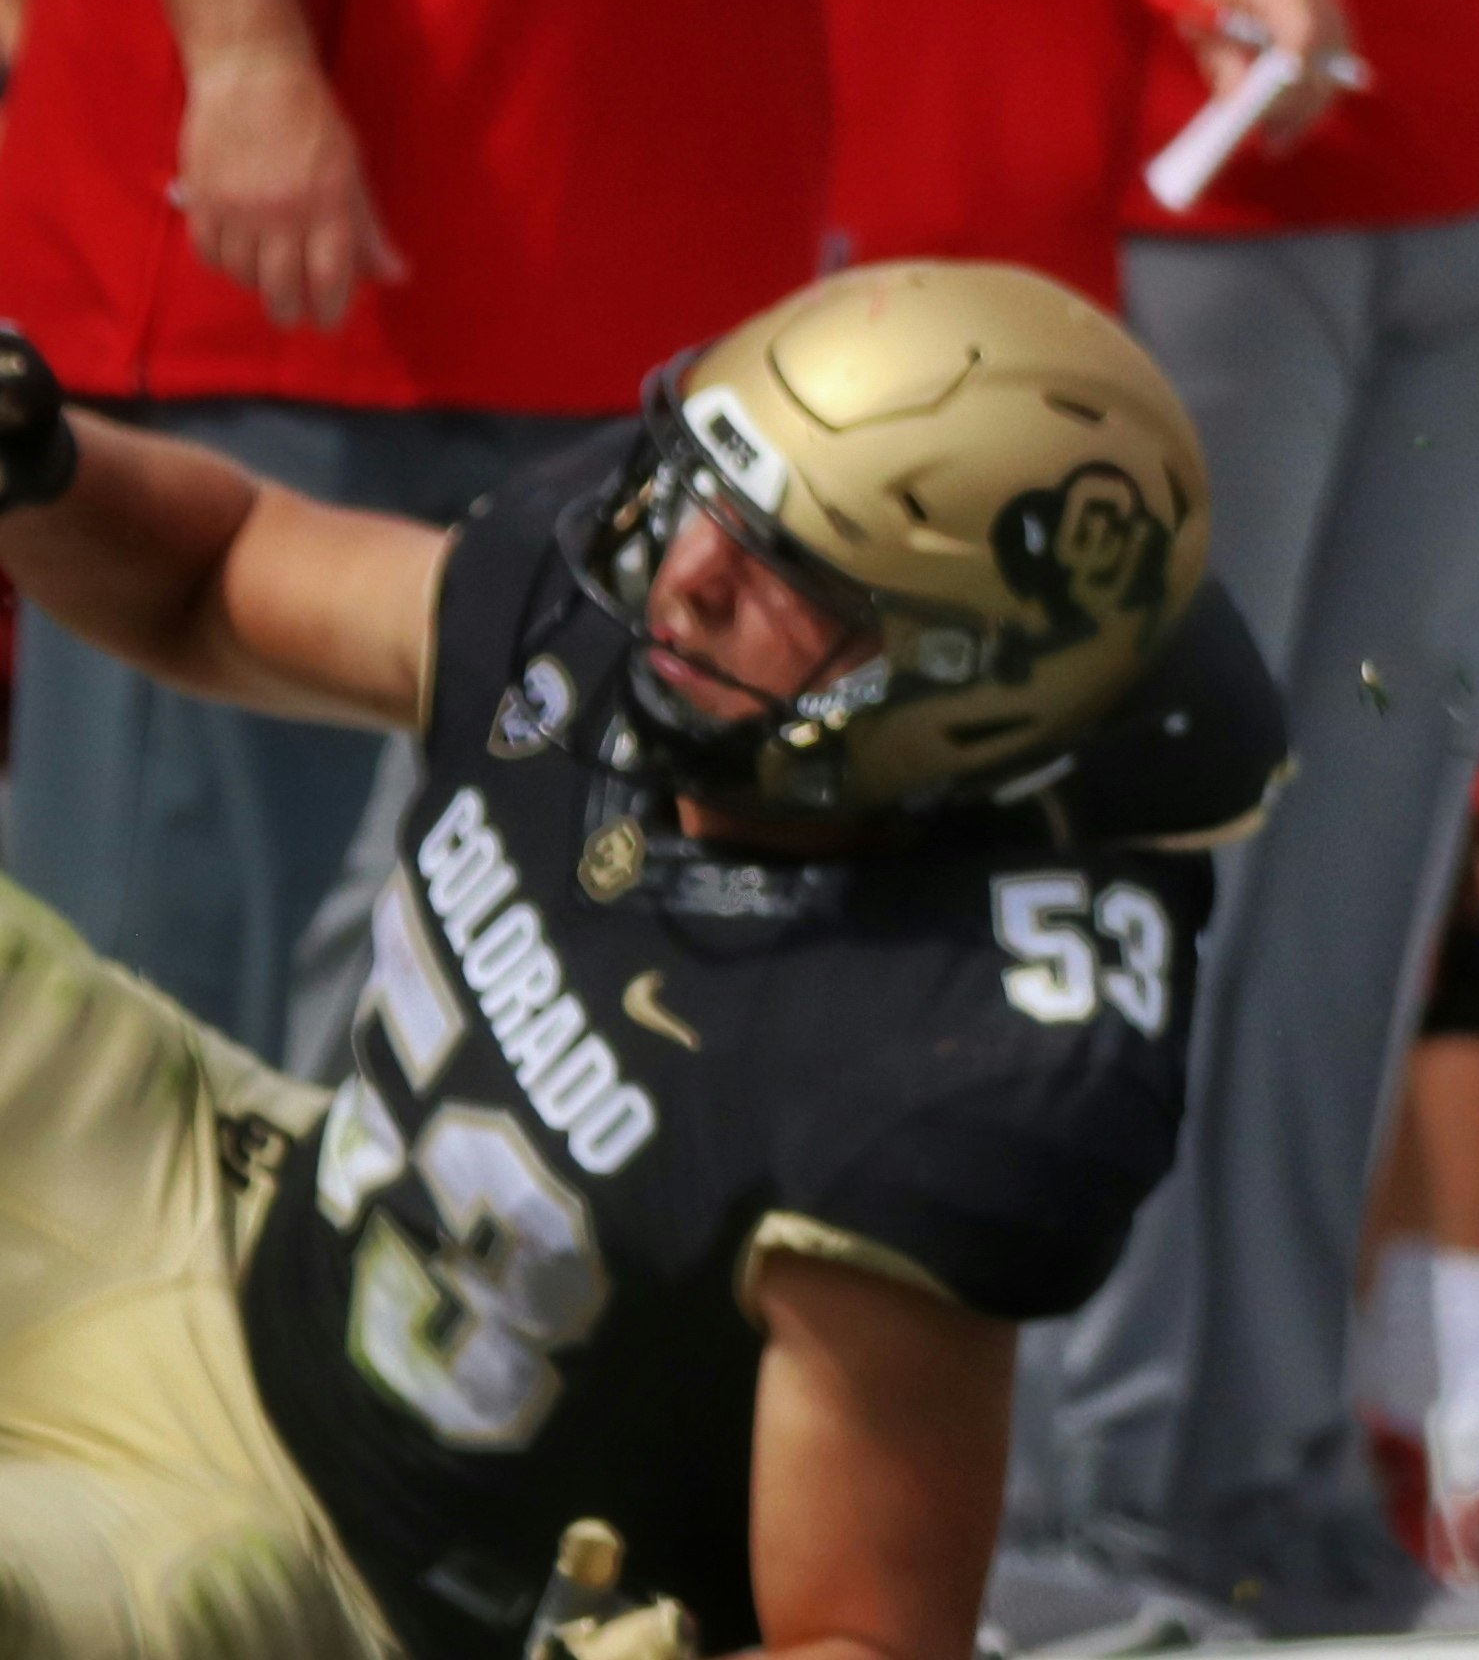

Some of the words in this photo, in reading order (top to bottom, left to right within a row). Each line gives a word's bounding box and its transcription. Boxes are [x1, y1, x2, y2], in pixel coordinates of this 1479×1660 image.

[417, 786, 657, 1176] COLORADO
[988, 868, 1172, 1040] 53
[315, 854, 612, 1453] 53
